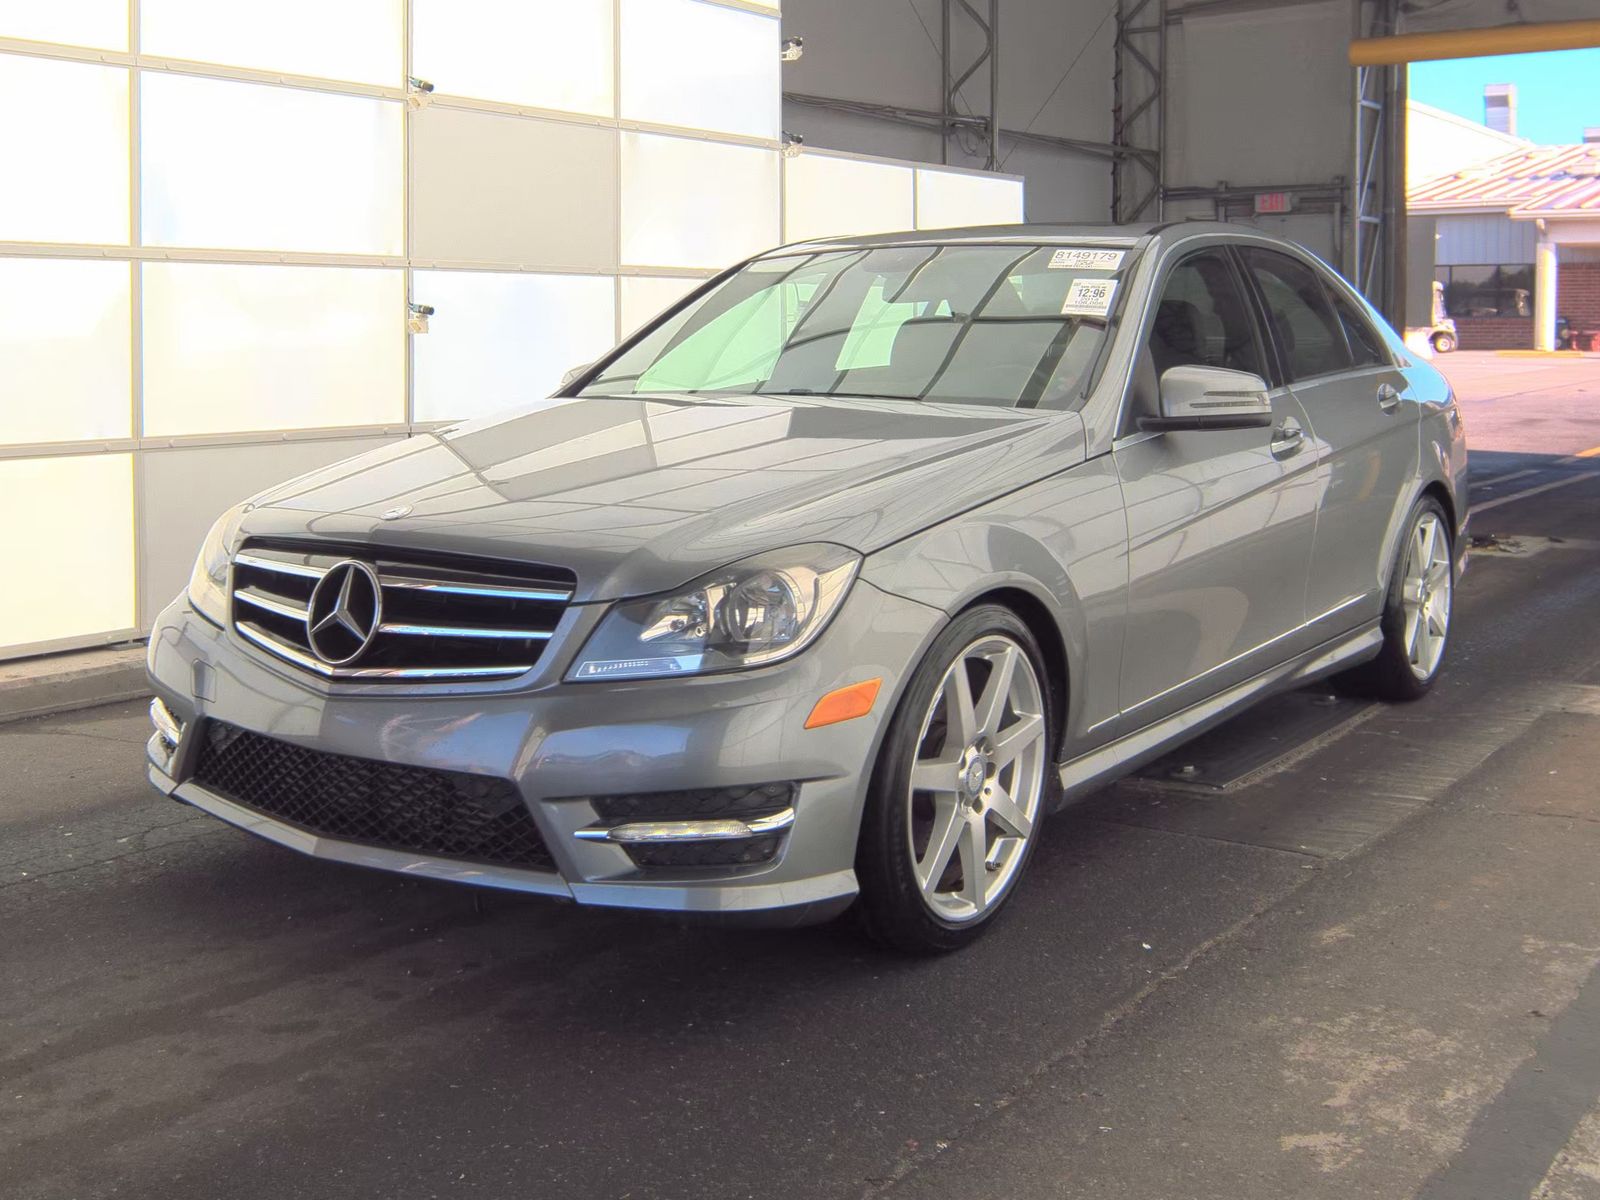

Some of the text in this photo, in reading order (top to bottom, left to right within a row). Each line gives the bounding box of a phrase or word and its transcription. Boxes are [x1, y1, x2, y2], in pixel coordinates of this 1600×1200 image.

[1260, 192, 1284, 210] EXIT
[1055, 251, 1118, 260] 8149179
[1078, 288, 1106, 298] 12:96
